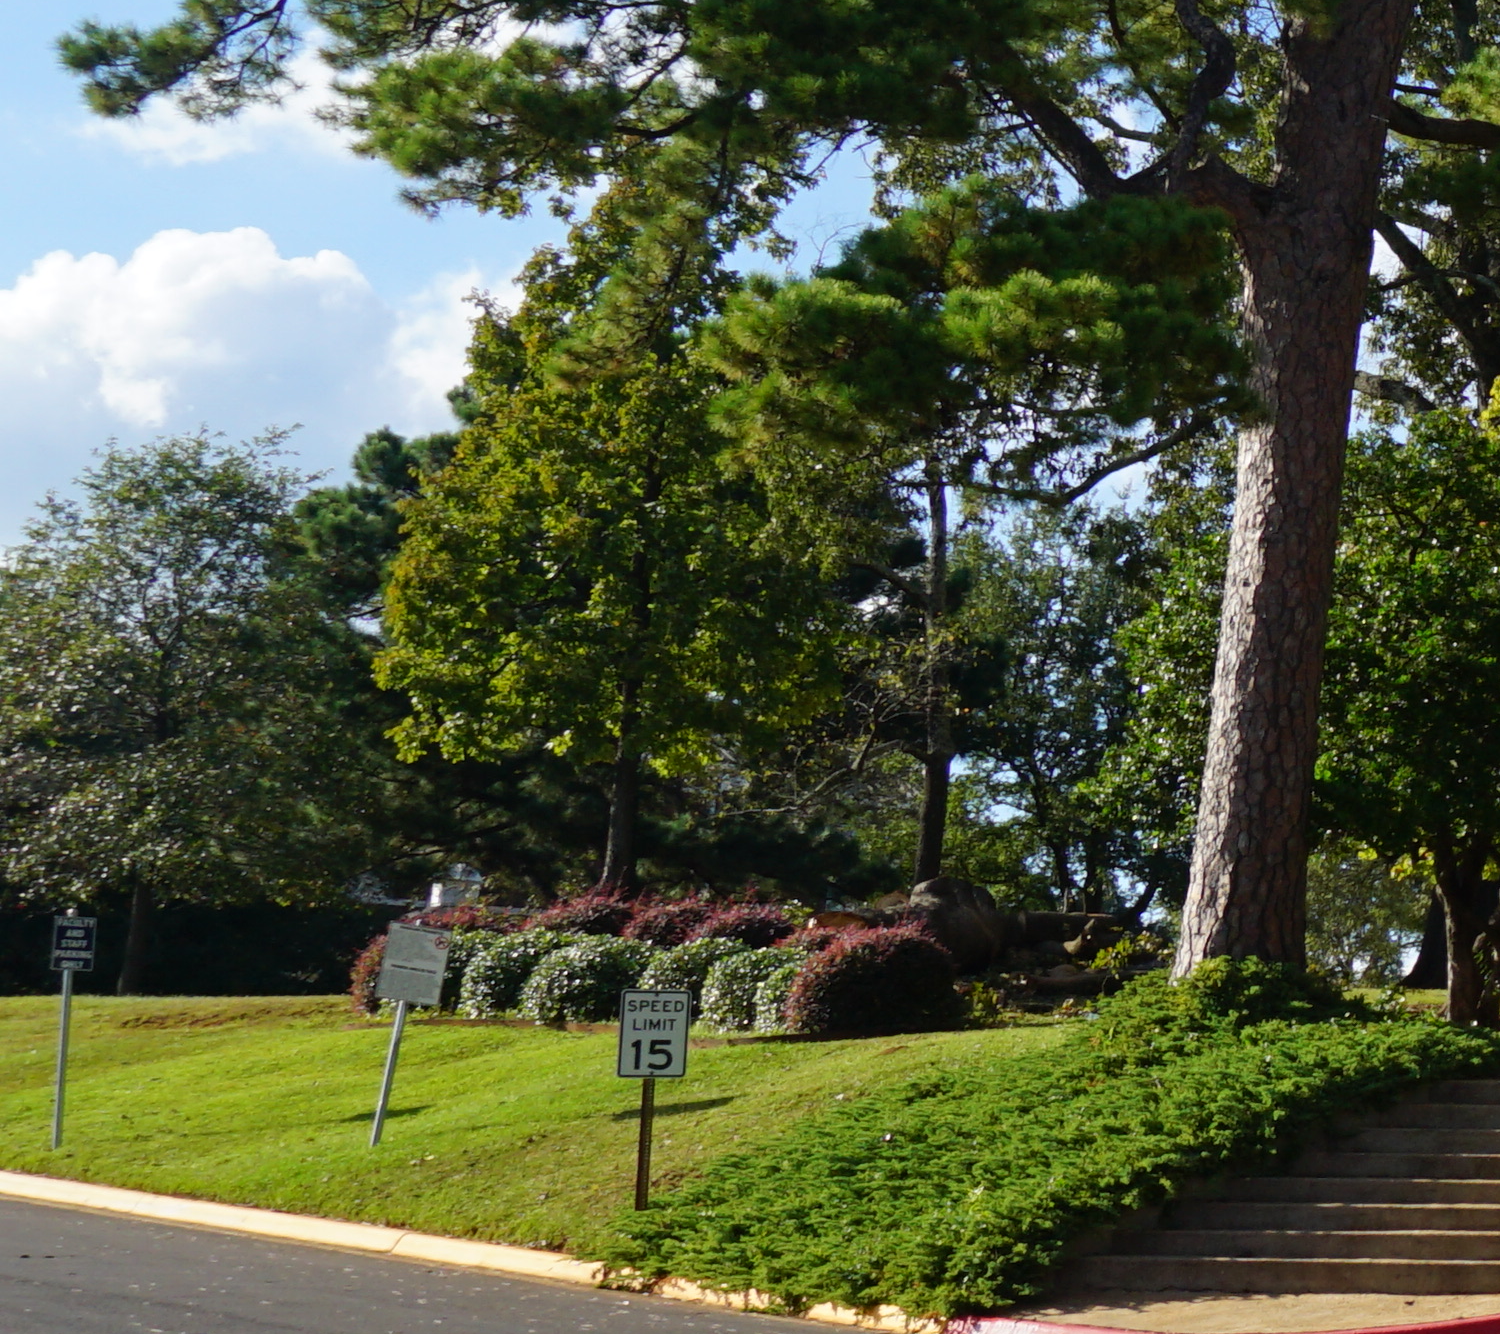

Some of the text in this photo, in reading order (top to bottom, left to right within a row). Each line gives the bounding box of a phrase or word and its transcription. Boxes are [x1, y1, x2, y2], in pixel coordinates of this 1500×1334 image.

[627, 1000, 684, 1012] SPEED
[632, 1018, 677, 1031] LIMIT
[630, 1039, 673, 1071] 15
